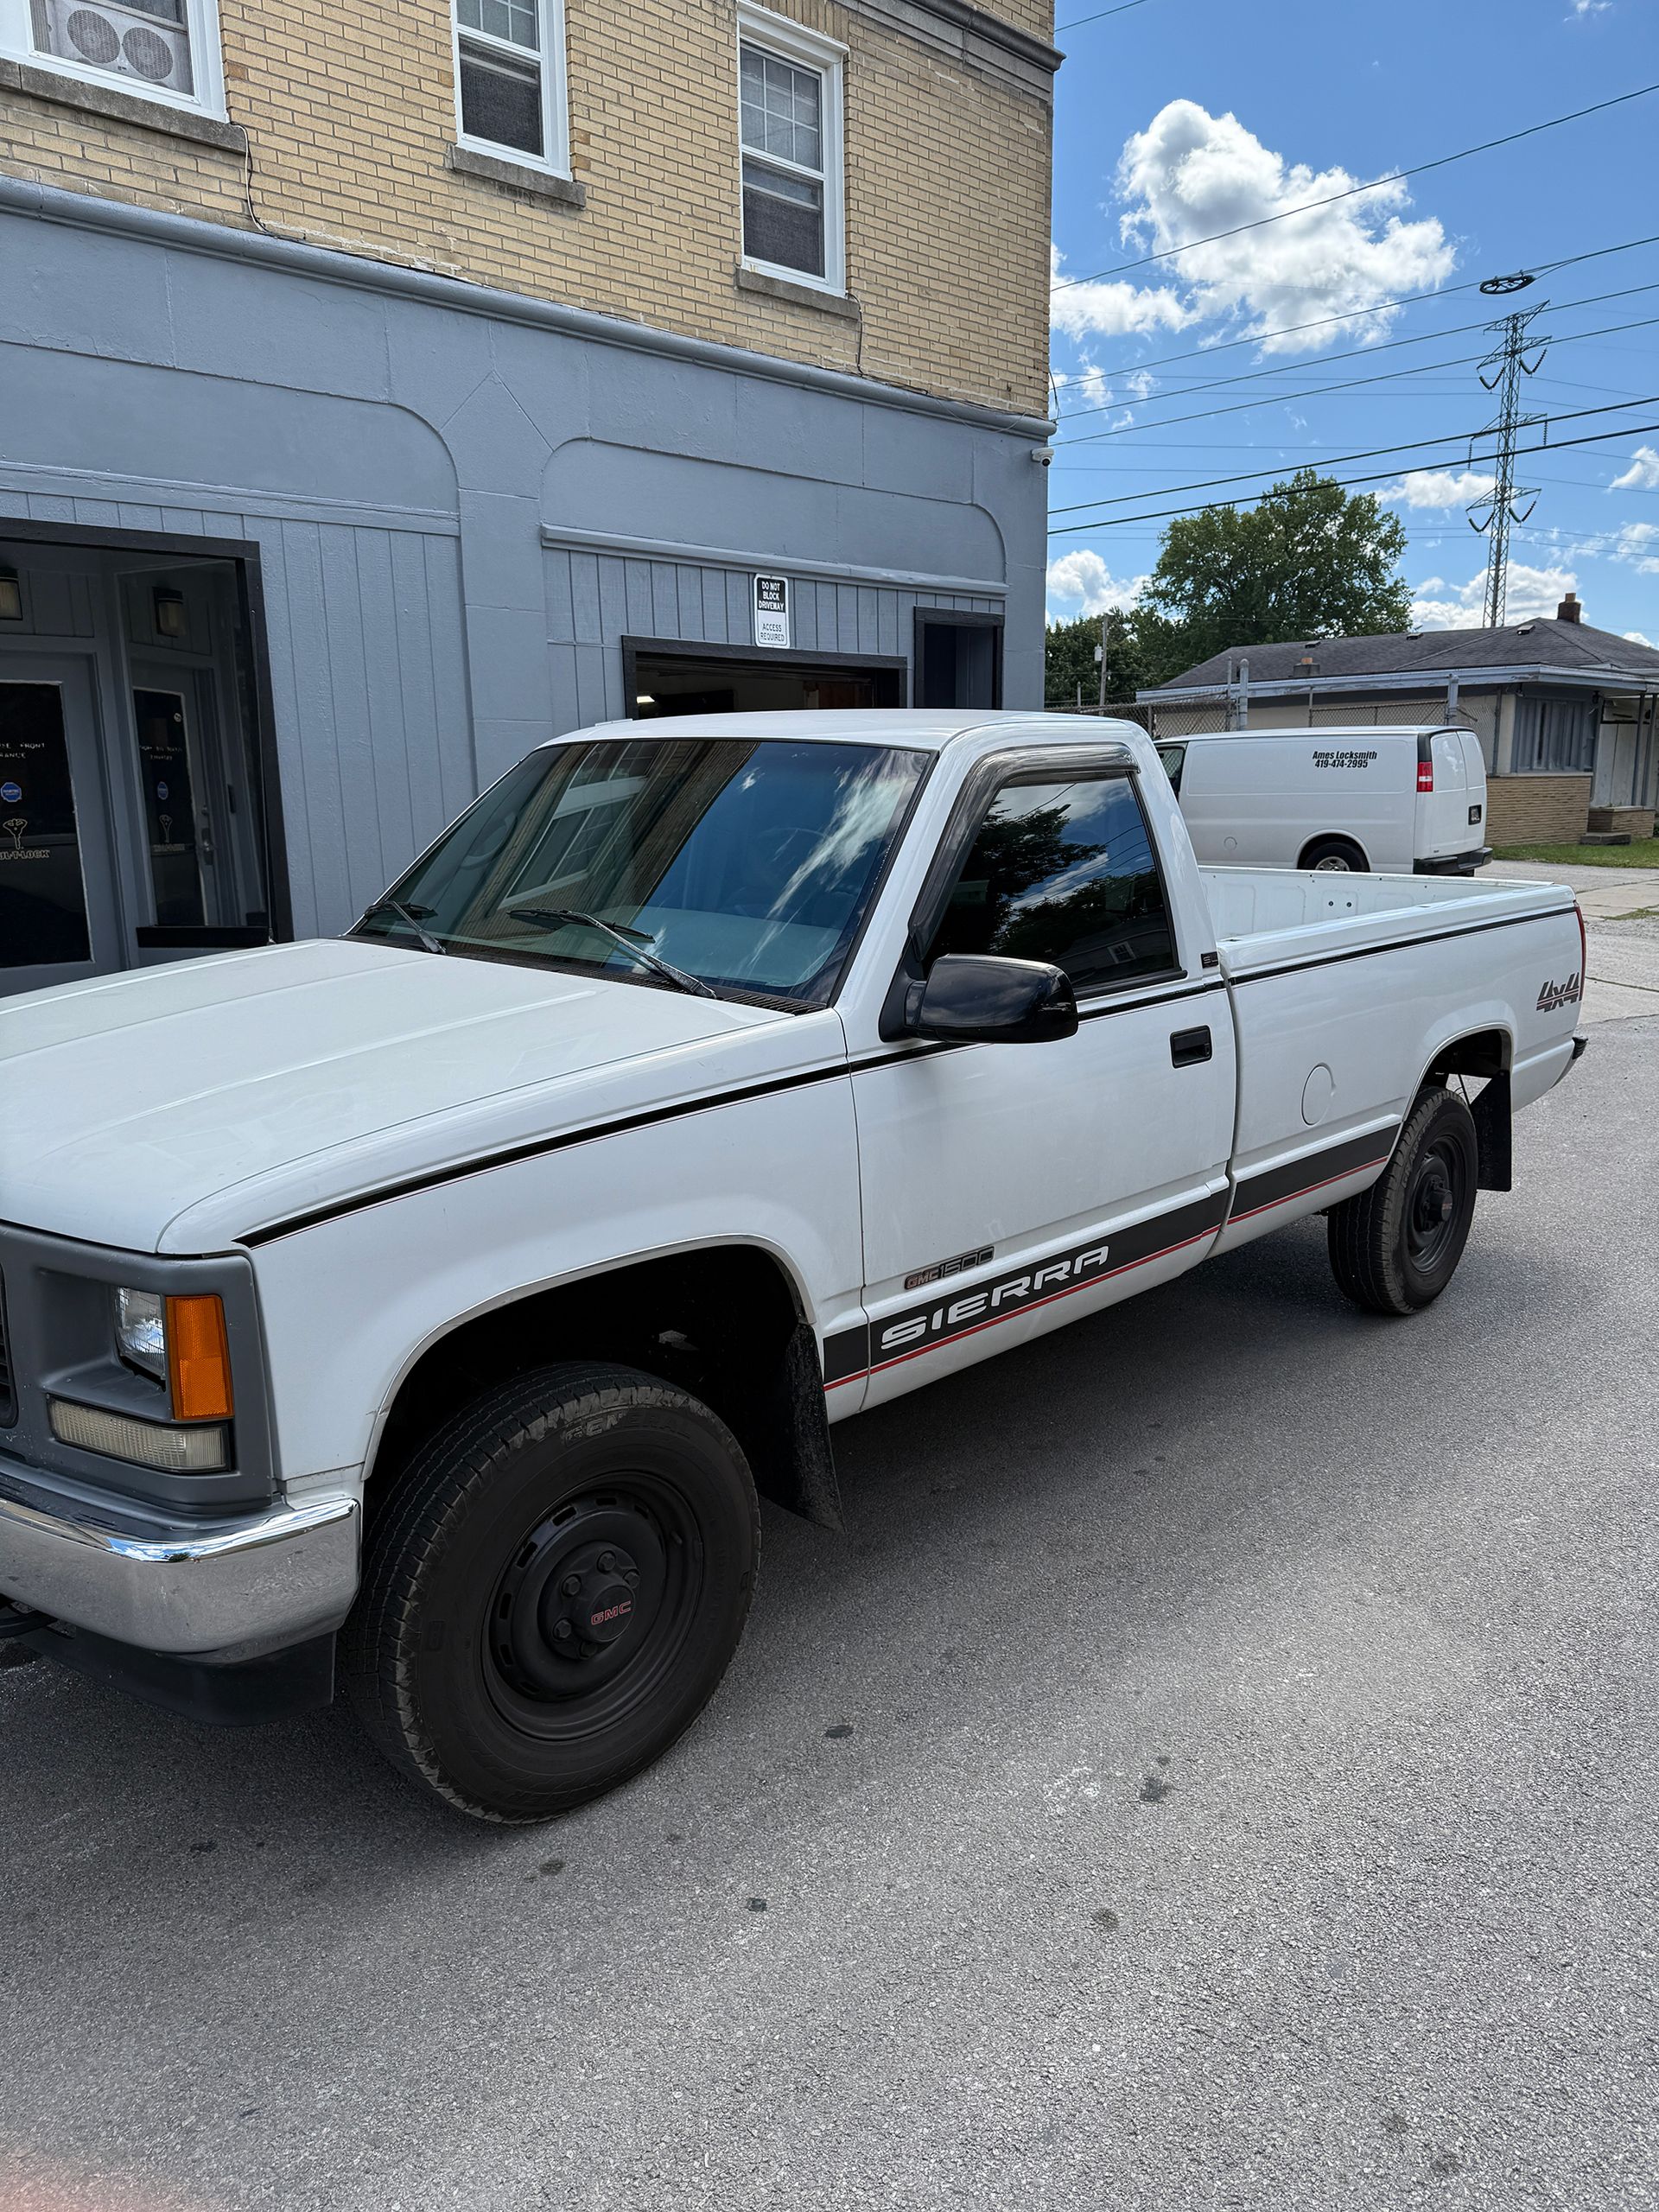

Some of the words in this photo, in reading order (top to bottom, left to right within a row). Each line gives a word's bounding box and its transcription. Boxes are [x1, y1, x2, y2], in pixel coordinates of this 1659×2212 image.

[761, 581, 769, 589] DO
[770, 582, 780, 591] NOT
[762, 591, 780, 601] BLOCK
[759, 601, 784, 610] DRIVEWAY
[762, 623, 782, 632] ACCESS
[760, 632, 785, 641] REQUIRED
[1313, 751, 1335, 760] Ames
[1336, 751, 1377, 760] Locksmith
[1315, 760, 1369, 768] 419-474-2995
[1536, 972, 1580, 1013] 4x4
[880, 1245, 1109, 1350] SIERRA
[590, 1600, 632, 1625] GMC
